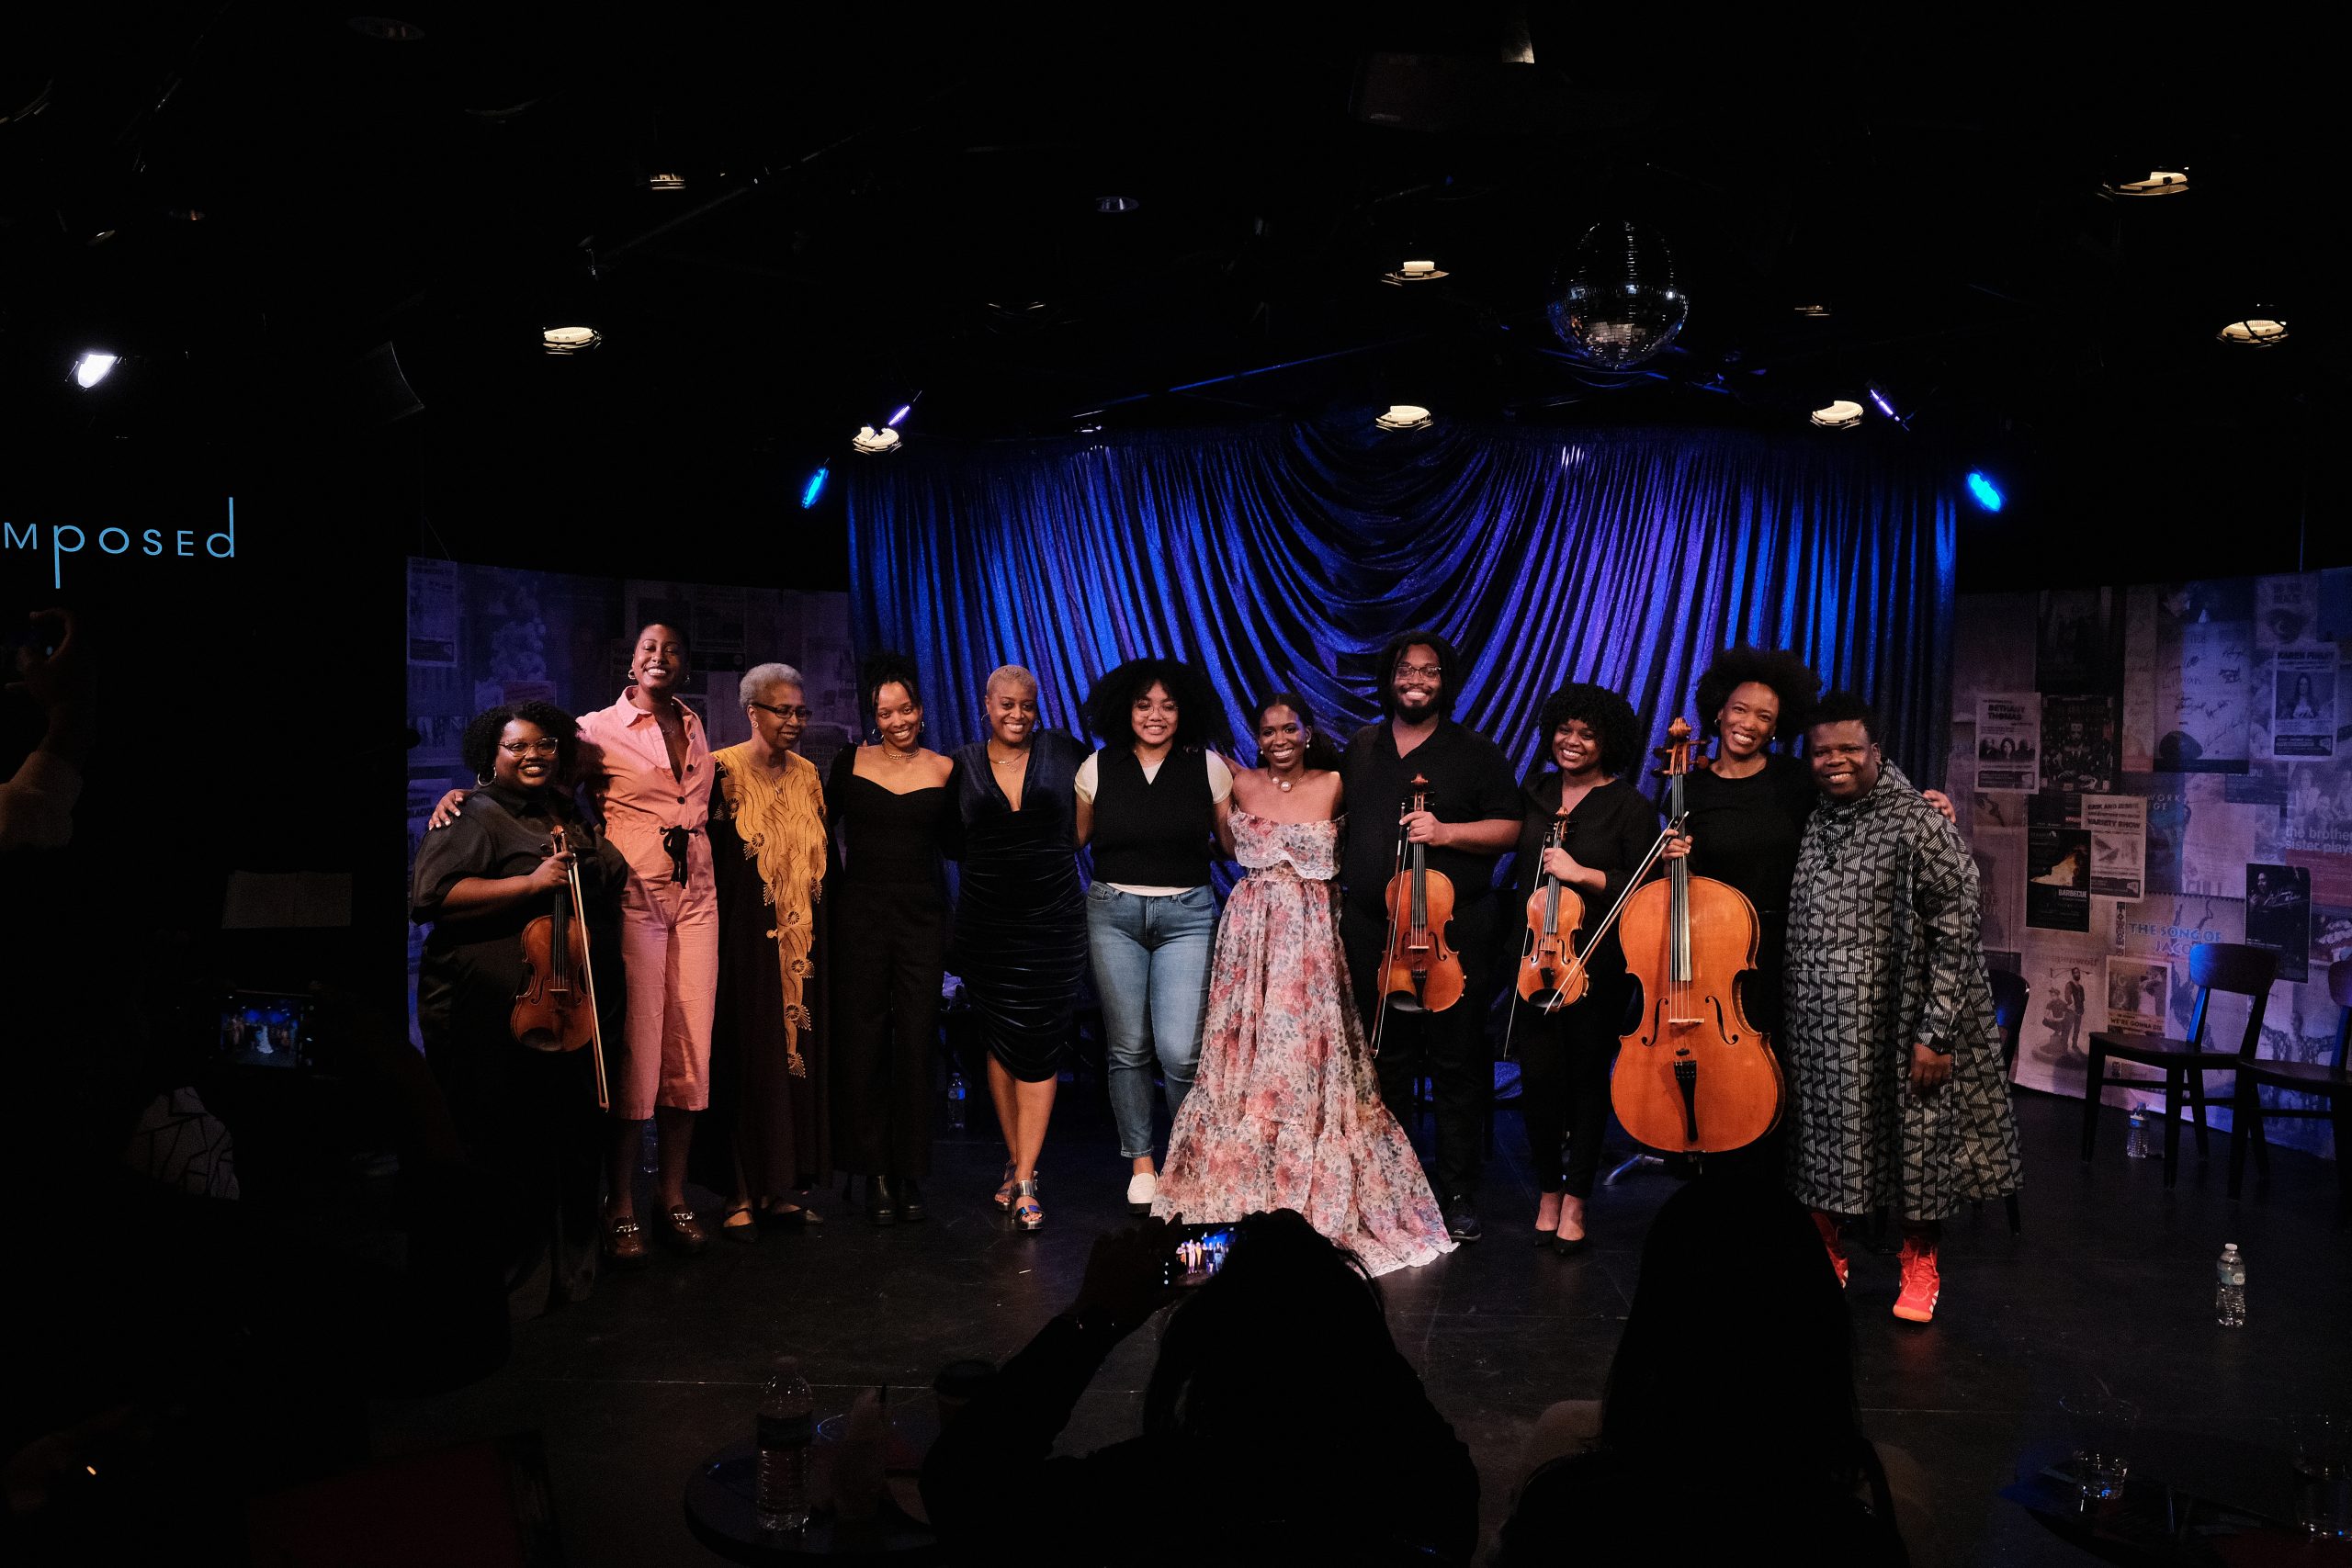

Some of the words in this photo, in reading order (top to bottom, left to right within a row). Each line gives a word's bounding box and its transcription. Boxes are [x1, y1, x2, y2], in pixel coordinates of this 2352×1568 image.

[1987, 705, 2026, 713] BETHANY
[1987, 712, 2022, 721] THOMAS
[2086, 818, 2117, 827] VARIETY
[2118, 820, 2141, 829] SHOW
[2286, 825, 2306, 839] the
[2285, 840, 2321, 852] sister
[2058, 889, 2087, 898] BARBECUE
[2129, 923, 2157, 935] THE
[2160, 927, 2199, 941] SONG
[2203, 931, 2222, 942] OF
[2154, 941, 2192, 956] JACO
[2130, 1021, 2152, 1029] GONNA
